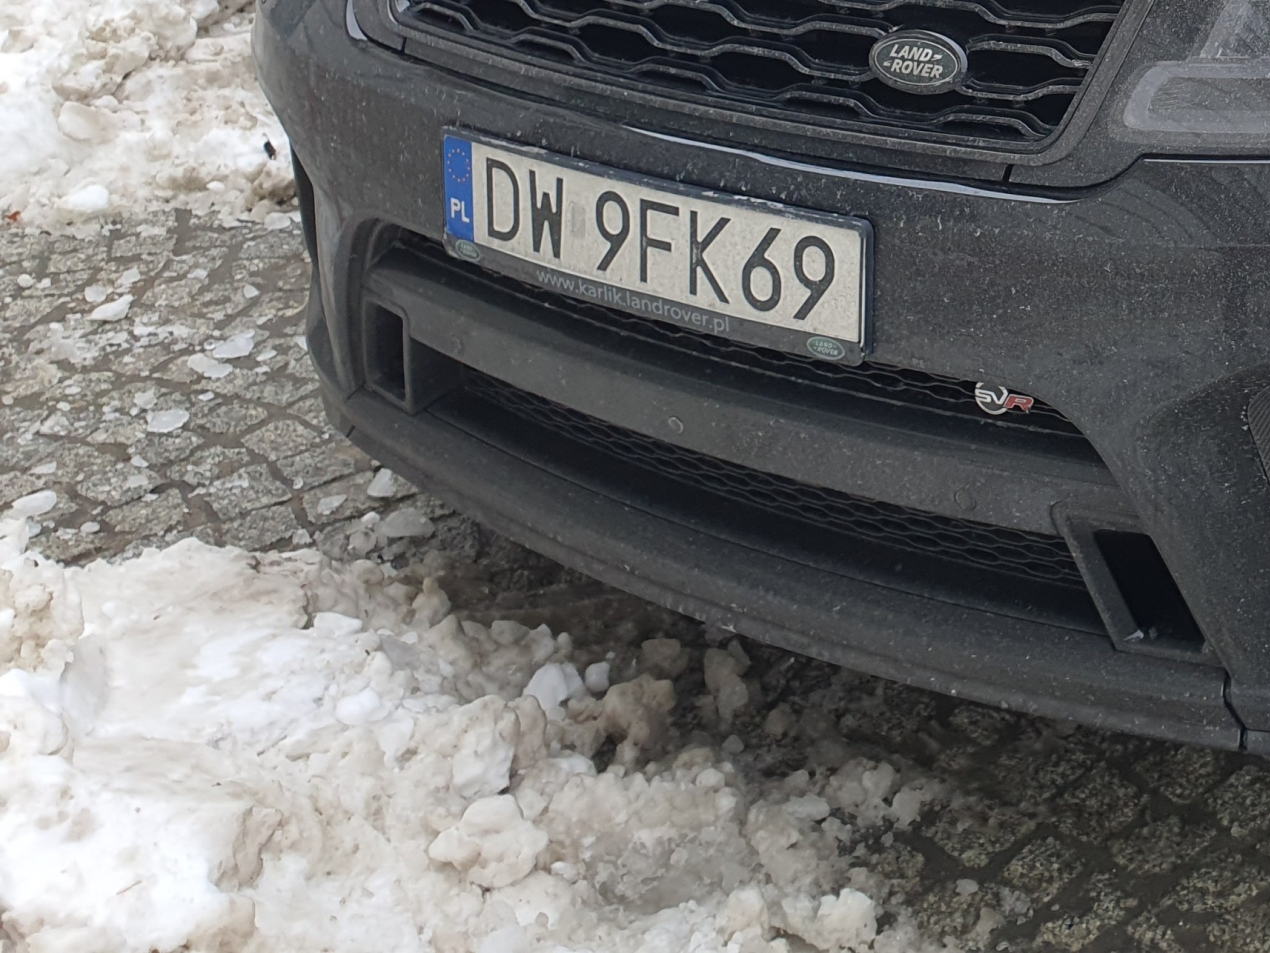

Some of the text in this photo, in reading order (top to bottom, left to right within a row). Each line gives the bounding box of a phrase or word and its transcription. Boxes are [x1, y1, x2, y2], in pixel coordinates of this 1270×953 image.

[889, 44, 933, 61] LAND
[891, 59, 943, 78] ROVER
[450, 198, 470, 223] PL
[486, 157, 835, 321] DW 9FK69
[536, 269, 729, 334] www.karlik.landrover.pl
[975, 387, 1034, 414] SVR
